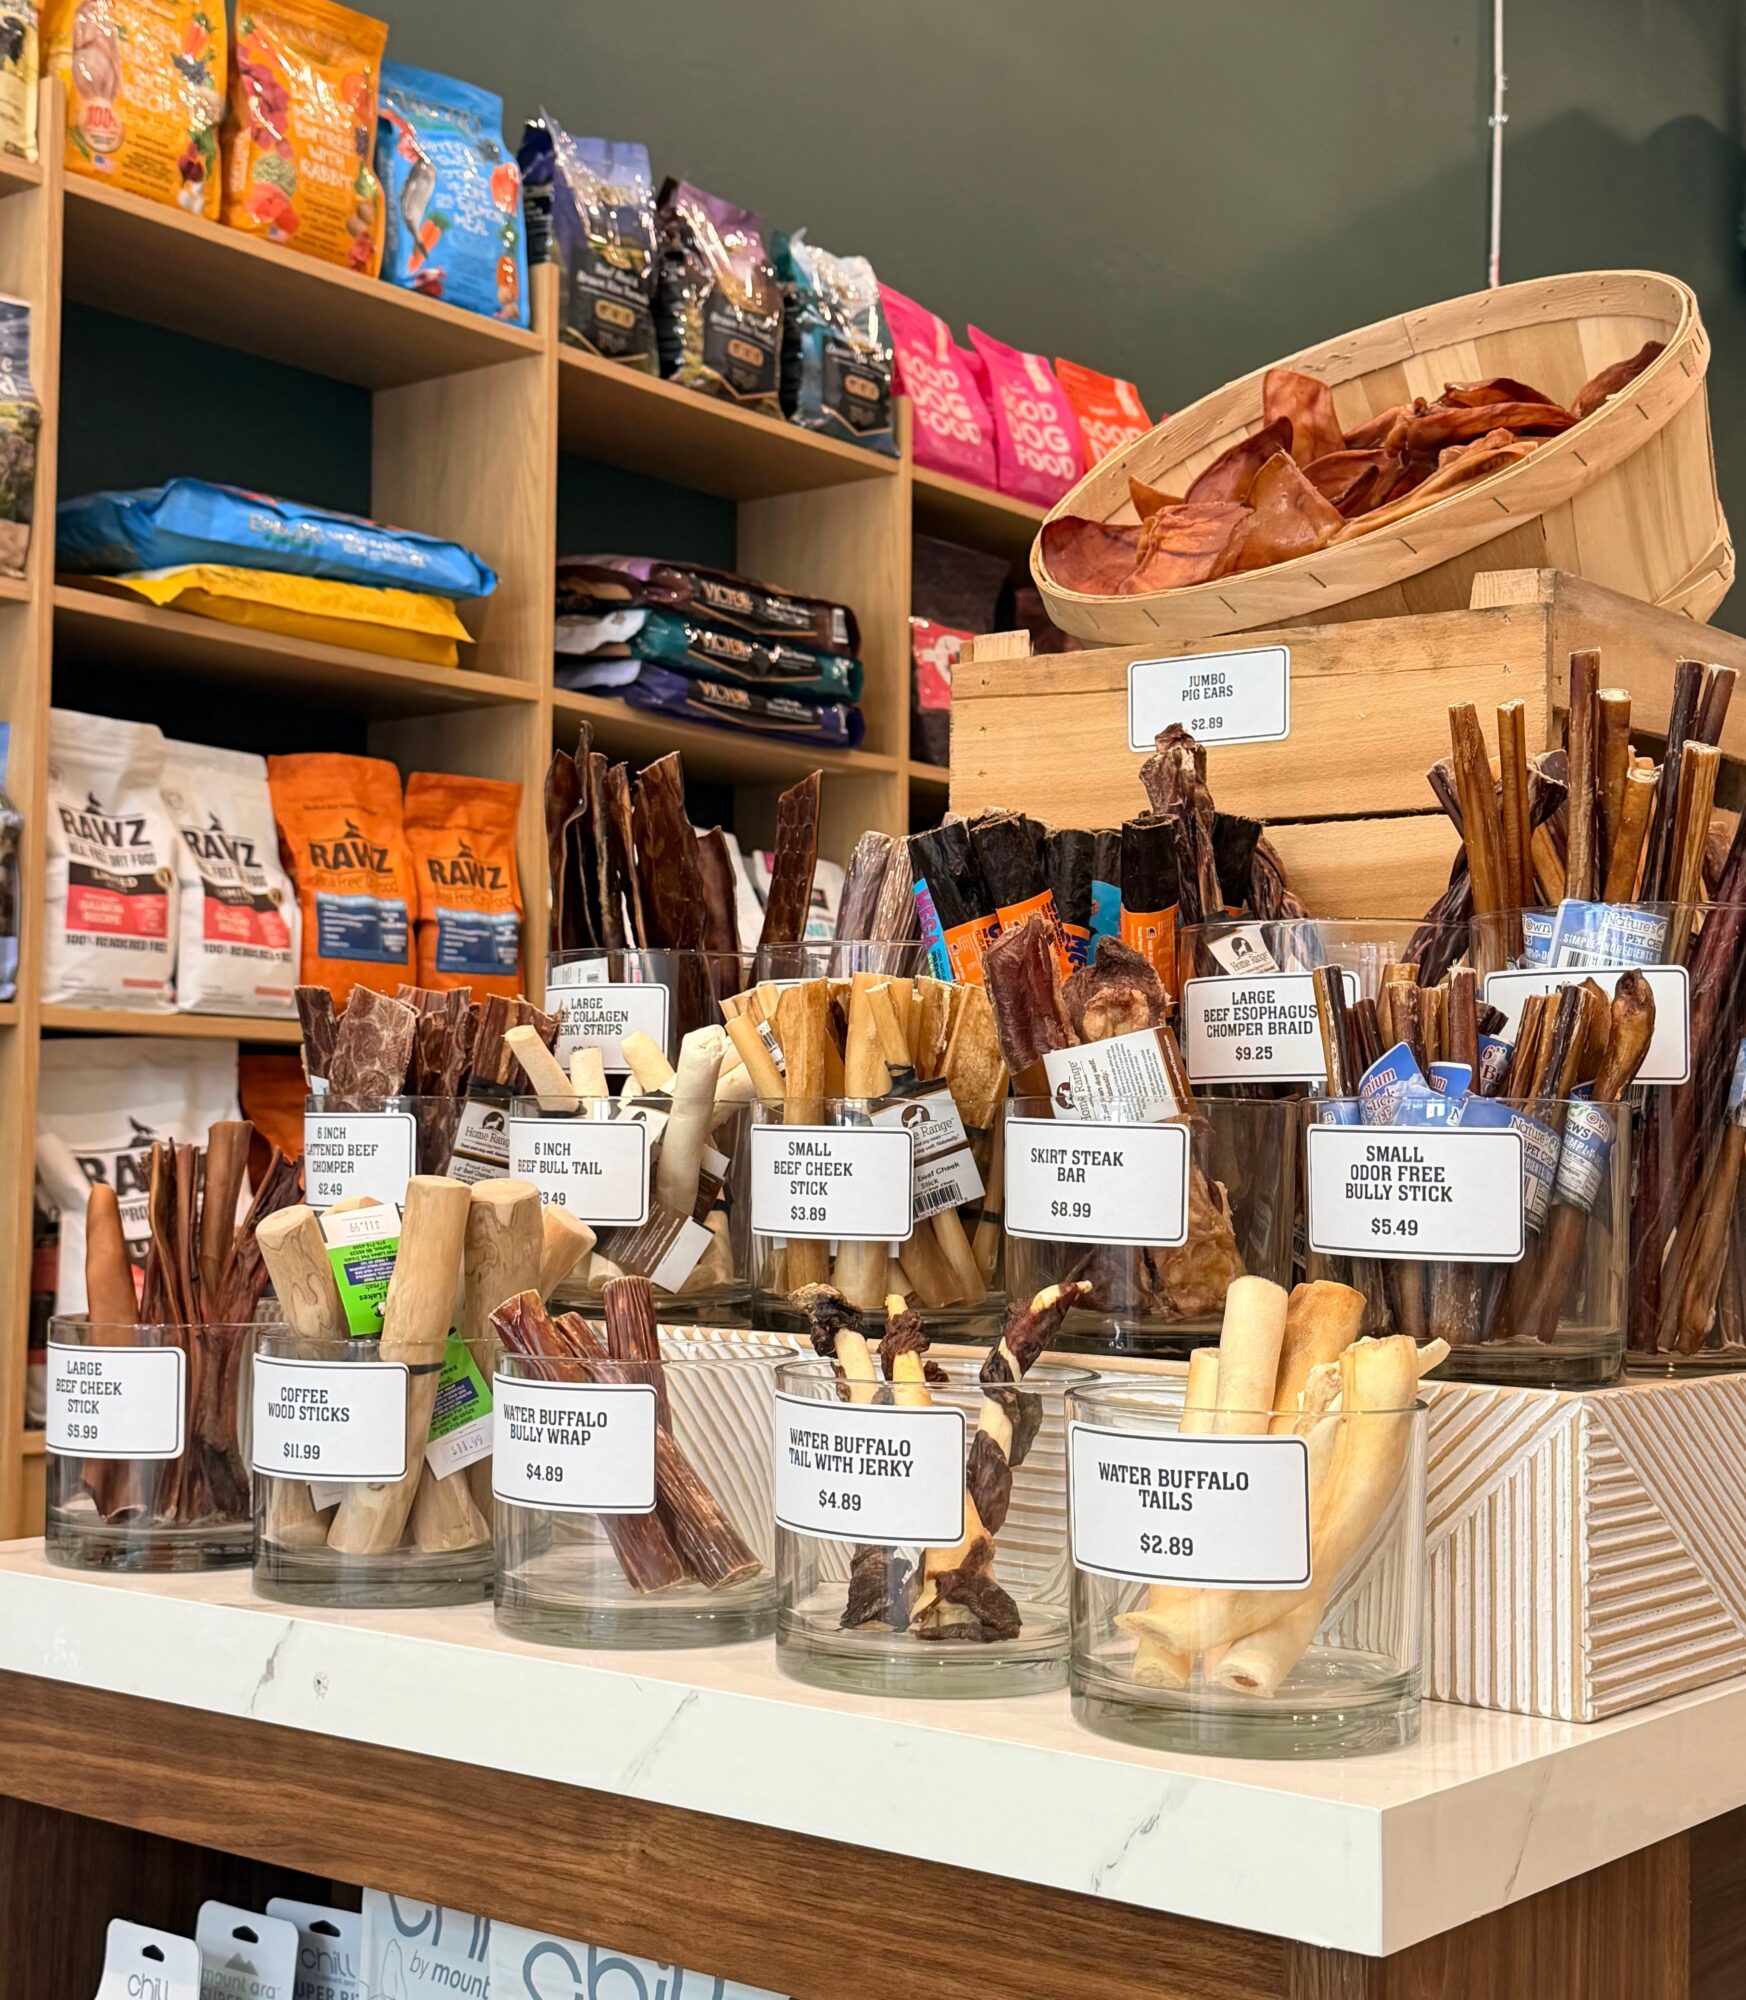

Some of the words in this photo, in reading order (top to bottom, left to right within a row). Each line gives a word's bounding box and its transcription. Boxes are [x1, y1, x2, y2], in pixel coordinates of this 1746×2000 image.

[1005, 411, 1072, 455] DOG
[1014, 444, 1077, 480] FOOD
[700, 580, 753, 609] VICTOR
[700, 631, 752, 657] VICTOR
[1188, 672, 1226, 688] JUMBO
[698, 680, 751, 706] VICTOR
[1182, 689, 1200, 702] PIG
[1203, 685, 1234, 700] EARS
[1191, 716, 1223, 731] $2.89
[58, 807, 152, 847] RAWZ
[131, 852, 158, 867] FOOD
[308, 842, 393, 874] RAWZ
[426, 858, 508, 891] RAWZ
[1625, 933, 1646, 946] PET
[571, 998, 603, 1010] LARGE
[1232, 990, 1275, 1006] LARGE
[573, 1011, 629, 1023] COLLAGEN
[1204, 1008, 1230, 1023] BEEF
[1234, 1005, 1318, 1021] ESOPHAGUS
[560, 1025, 582, 1036] ERKY
[583, 1024, 623, 1036] STRIPS
[1207, 1023, 1263, 1038] CHOMPER
[1268, 1021, 1313, 1036] BRAID
[1235, 1046, 1273, 1062] $9.25
[1370, 1106, 1393, 1126] REE
[317, 1126, 322, 1139] 6
[324, 1127, 347, 1139] INCH
[465, 1126, 489, 1141] Home
[490, 1132, 510, 1147] Rang
[921, 1118, 953, 1138] Range
[1566, 1120, 1591, 1139] EWS
[347, 1144, 379, 1156] BEEF
[534, 1142, 540, 1155] 6
[543, 1142, 571, 1156] INCH
[788, 1141, 832, 1157] SMALL
[1031, 1147, 1067, 1165] SKIRT
[1072, 1150, 1124, 1167] STEAK
[1366, 1145, 1424, 1163] SMALL
[1526, 1143, 1541, 1156] PET
[312, 1160, 354, 1173] CHOMPER
[518, 1159, 537, 1173] BEEF
[539, 1161, 568, 1174] BULL
[572, 1161, 602, 1175] TAIL
[774, 1161, 802, 1175] BEEF
[805, 1162, 853, 1177] CHEEK
[936, 1161, 960, 1175] Cheek
[1057, 1167, 1086, 1183] BAR
[1350, 1164, 1392, 1182] ODOR
[1398, 1165, 1445, 1183] FREE
[318, 1182, 343, 1196] $2.49
[790, 1181, 828, 1196] STICK
[920, 1178, 940, 1190] Stick
[1345, 1183, 1392, 1201] BULLY
[1398, 1184, 1453, 1203] STICK
[790, 1206, 826, 1221] $3.89
[1051, 1200, 1092, 1218] $8.99
[1371, 1217, 1418, 1236] $5.49
[358, 1292, 383, 1301] Lakes
[67, 1360, 102, 1376] LARGE
[56, 1378, 77, 1393] BEEF
[80, 1380, 122, 1396] CHEEK
[280, 1387, 328, 1404] COFFEE
[67, 1399, 100, 1414] STICK
[268, 1402, 295, 1419] WOOD
[299, 1405, 350, 1422] STICKS
[503, 1403, 535, 1424] WATER
[539, 1409, 608, 1428] BUFFALO
[67, 1424, 98, 1439] $5.99
[510, 1423, 544, 1443] BULLY
[547, 1428, 591, 1446] WRAP
[283, 1442, 320, 1460] $11.99
[789, 1427, 829, 1451] WATER
[834, 1435, 911, 1457] BUFFALO
[789, 1447, 811, 1468] TAIL
[815, 1452, 853, 1474] WITH
[858, 1457, 914, 1477] JERKY
[526, 1463, 563, 1482] $4.89
[1098, 1461, 1151, 1486] WATER
[1158, 1468, 1249, 1491] BUFFALO
[819, 1489, 861, 1511] $4.89
[1139, 1489, 1193, 1511] TAILS
[1140, 1532, 1193, 1556] $2.89
[301, 1948, 356, 1979] chill
[202, 1967, 247, 1992] mount
[250, 1982, 277, 2000] ara
[409, 1949, 430, 1975] by
[431, 1962, 491, 2000] mount
[127, 1973, 168, 2000] chill
